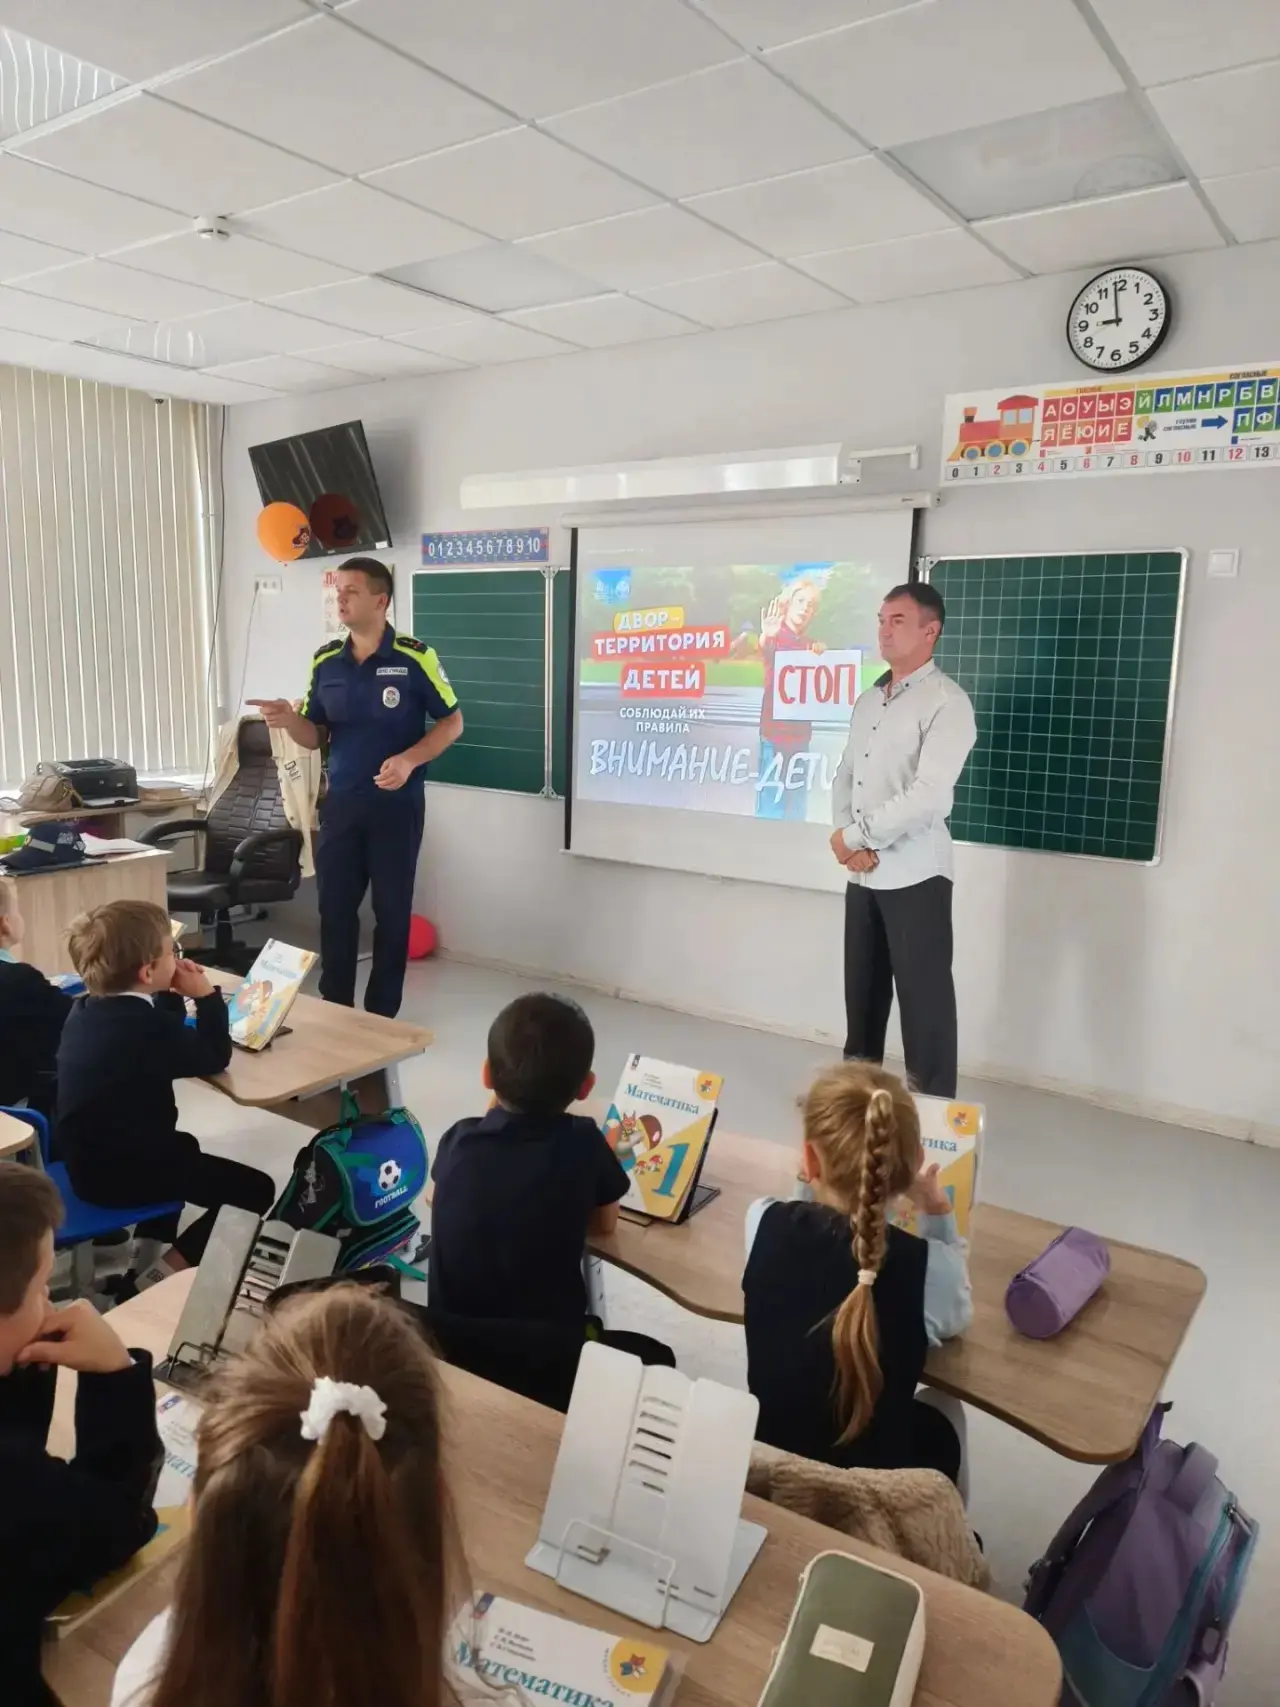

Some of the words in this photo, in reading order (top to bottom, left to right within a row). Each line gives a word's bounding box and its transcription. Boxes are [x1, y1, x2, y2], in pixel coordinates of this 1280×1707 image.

[1112, 279, 1127, 292] 12
[1134, 282, 1140, 294] 1
[1097, 287, 1108, 300] 11
[1143, 293, 1153, 305] 2
[1084, 302, 1099, 315] 10
[1148, 308, 1159, 321] 3
[1078, 320, 1089, 332] 9
[1141, 327, 1152, 339] 4
[1083, 336, 1093, 348] 8
[1129, 341, 1139, 354] 5
[1096, 346, 1105, 359] 7
[1110, 349, 1122, 361] 6
[1045, 404, 1057, 418] А
[1063, 402, 1075, 415] О
[1083, 400, 1094, 414] У
[1099, 399, 1114, 412] Ы
[1120, 397, 1132, 410] Э
[1139, 392, 1151, 409] Й
[1157, 393, 1170, 407] Л
[1177, 391, 1191, 406] М
[1198, 390, 1211, 404] Н
[1219, 389, 1231, 402] Р
[1240, 386, 1253, 400] Б
[1261, 384, 1274, 398] В
[1237, 413, 1250, 427] П
[1256, 411, 1273, 425] Ф
[1044, 428, 1055, 442] Я
[1062, 424, 1072, 440] Ё
[1077, 425, 1094, 439] Ю
[1098, 423, 1110, 437] И
[1118, 422, 1129, 435] Е
[952, 467, 959, 478] 0
[973, 466, 978, 476] 1
[994, 464, 1001, 475] 2
[1016, 462, 1023, 473] 3
[1037, 461, 1045, 472] 4
[1060, 459, 1068, 470] 5
[1083, 458, 1090, 469] 6
[1107, 456, 1115, 467] 7
[1130, 454, 1138, 466] 8
[1155, 453, 1163, 464] 9
[1177, 450, 1191, 463] 10
[1202, 450, 1215, 461] 11
[1228, 447, 1244, 460] 12
[1254, 446, 1270, 458] 13
[594, 630, 725, 656] ТЕРРИТОРИЯ
[623, 664, 701, 690] ДЕТЕЙ
[778, 664, 856, 706] СТОП
[619, 705, 687, 721] СОБЛЮДАЙ
[690, 708, 706, 719] ИХ
[636, 721, 691, 734] ПРАВИЛА
[624, 1083, 700, 1115] Математика
[651, 1143, 690, 1197] 1
[375, 1185, 408, 1209] FOOTBALL
